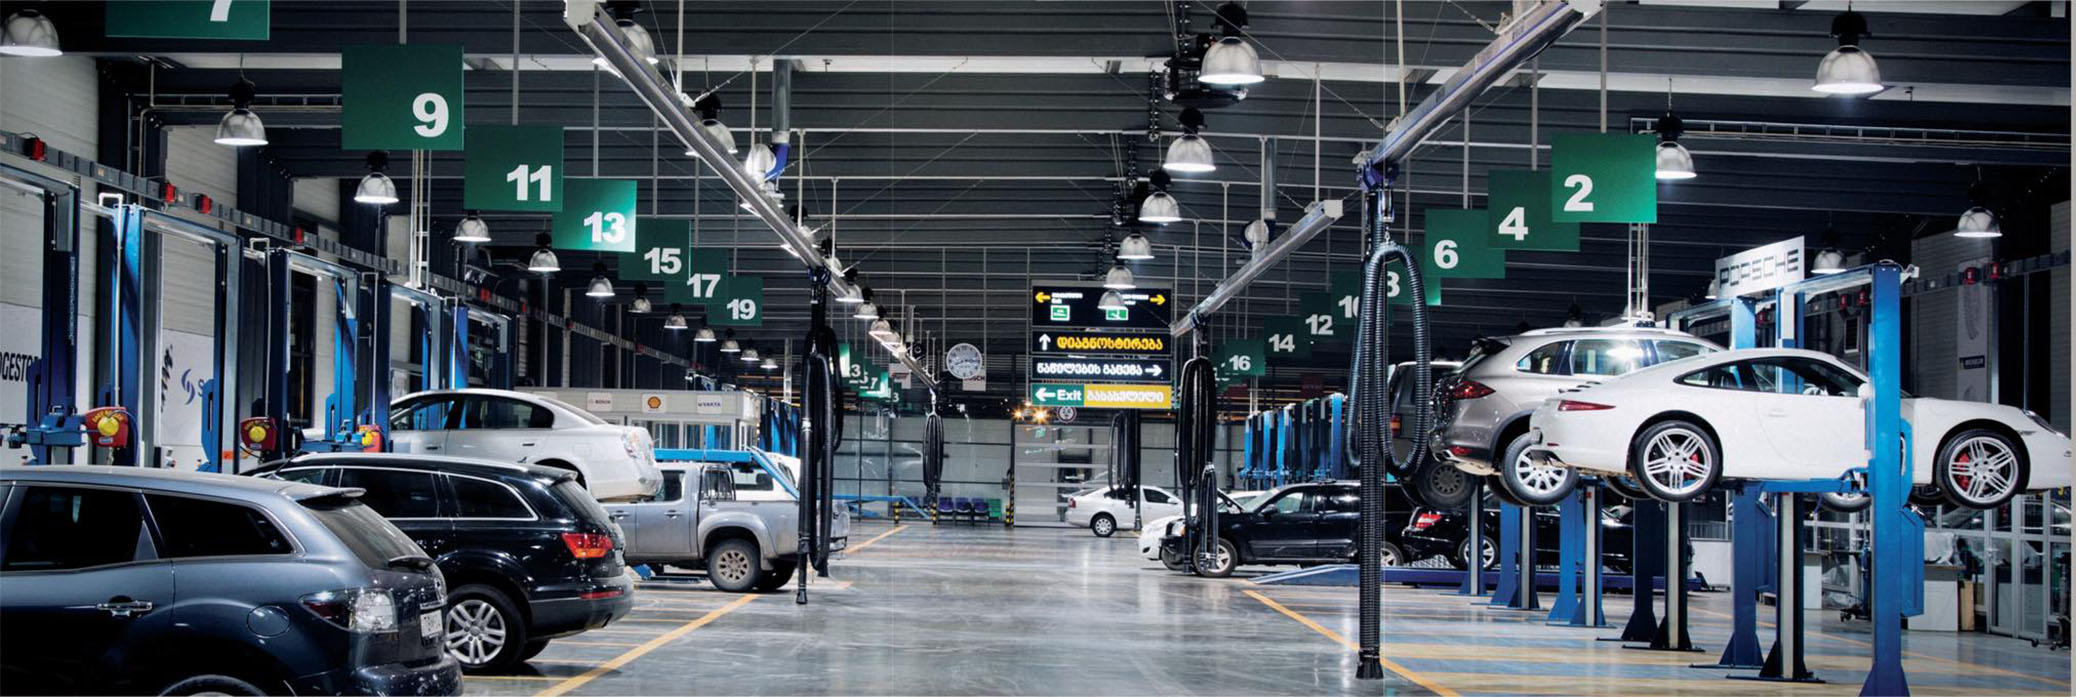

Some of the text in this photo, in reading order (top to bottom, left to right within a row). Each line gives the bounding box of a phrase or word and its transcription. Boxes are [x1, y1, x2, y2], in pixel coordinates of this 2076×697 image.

[412, 92, 449, 138] 9
[506, 164, 552, 202] 11
[1563, 174, 1594, 212] 2
[583, 211, 627, 244] 13
[1498, 206, 1529, 241] 4
[644, 247, 682, 275] 15
[1433, 239, 1459, 269] 6
[1719, 249, 1799, 289] PORSCHE
[687, 273, 720, 298] 17
[726, 298, 756, 320] 19
[1305, 314, 1334, 336] 12
[1268, 333, 1296, 353] 14
[1229, 354, 1251, 371] 16
[1057, 388, 1082, 401] Exit
